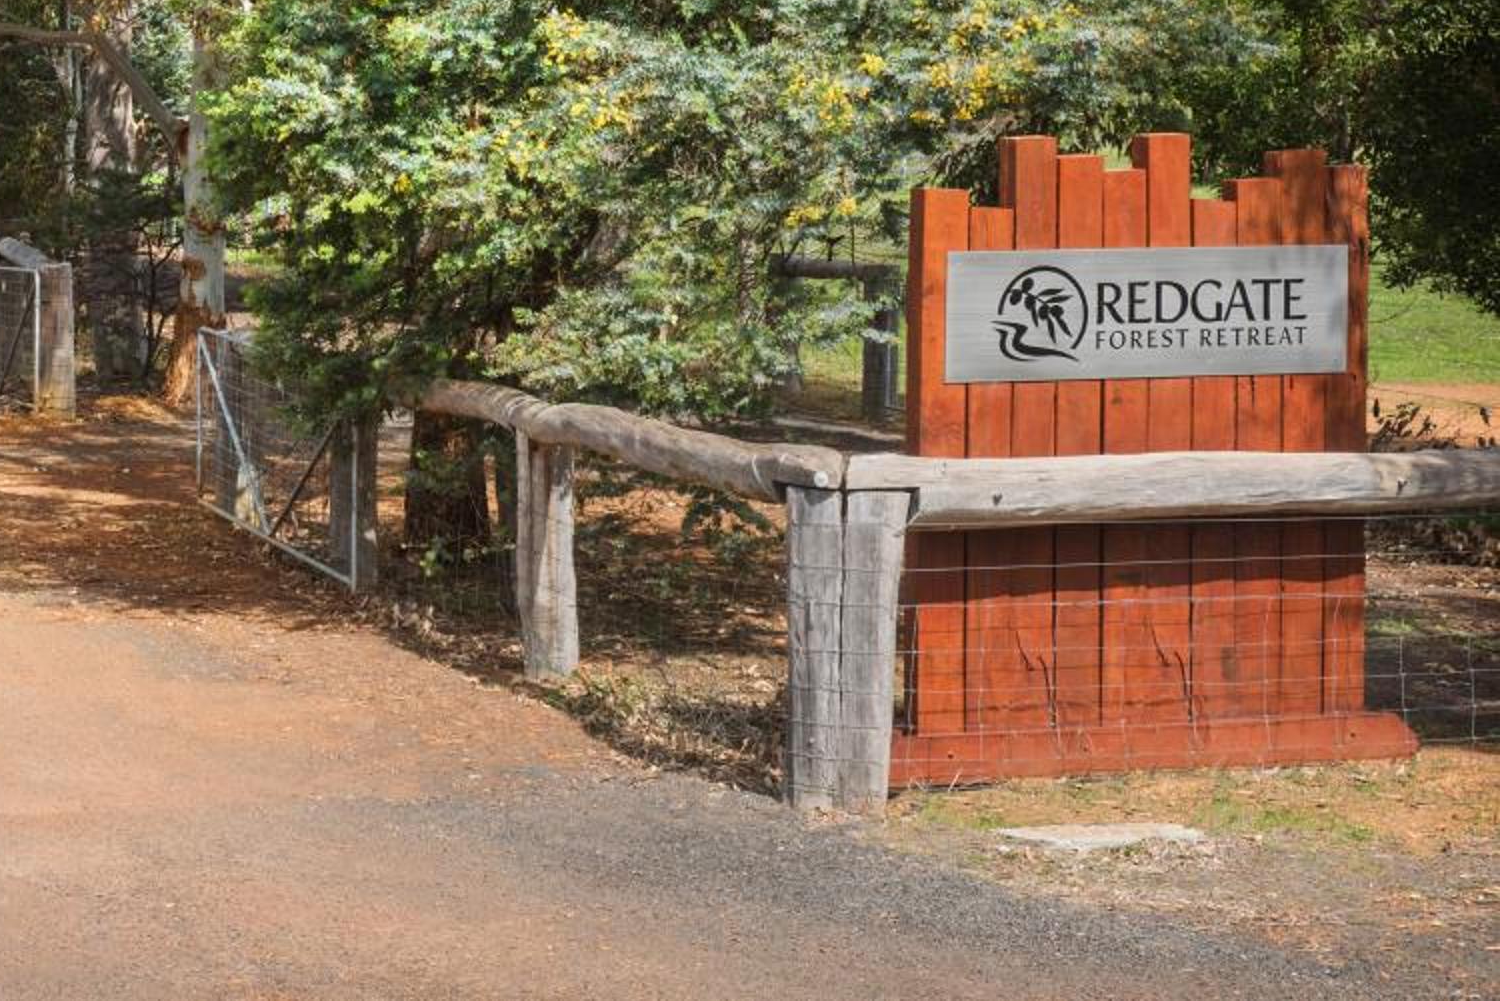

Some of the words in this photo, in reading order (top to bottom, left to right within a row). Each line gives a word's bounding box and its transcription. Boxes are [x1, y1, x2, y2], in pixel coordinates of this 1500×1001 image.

[1095, 278, 1308, 325] REDGATE
[1095, 328, 1189, 350] FOREST
[1199, 325, 1308, 347] RETREAT
